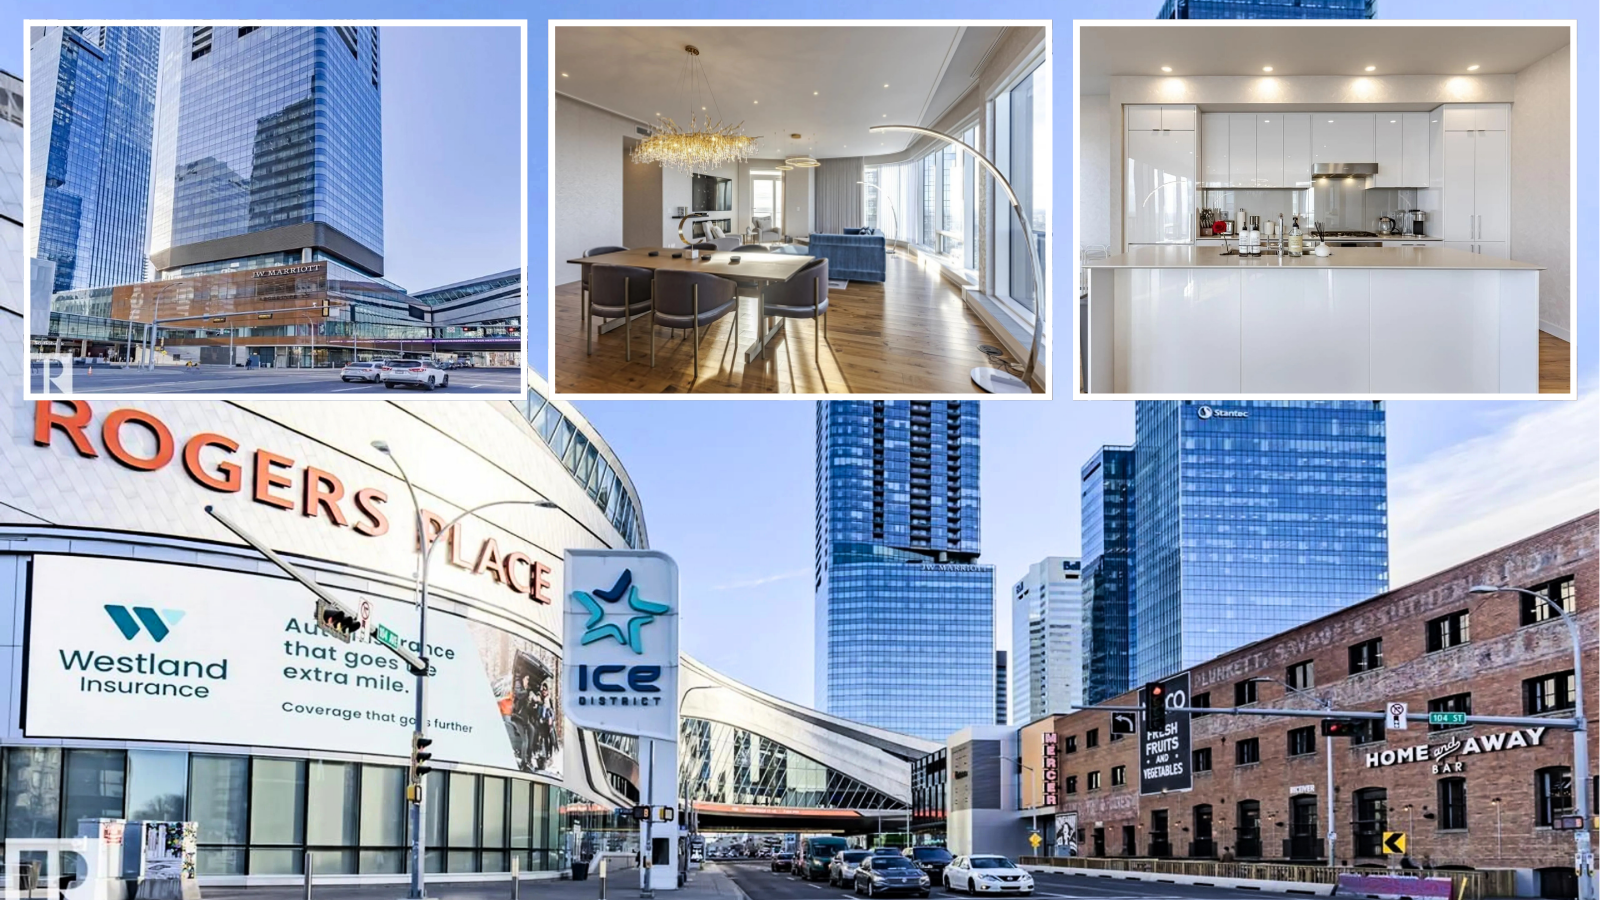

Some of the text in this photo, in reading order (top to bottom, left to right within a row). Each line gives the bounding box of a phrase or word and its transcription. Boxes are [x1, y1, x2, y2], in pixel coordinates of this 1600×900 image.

[251, 264, 321, 279] JW MARRIOTT
[1214, 408, 1249, 418] Stantec
[34, 400, 552, 605] ROGERS PLACE
[59, 649, 228, 681] Westland
[284, 640, 337, 661] that
[344, 651, 399, 670] goes
[80, 676, 210, 699] Insurance
[283, 666, 410, 694] extra mile.
[578, 696, 662, 706] DISTRICT
[281, 701, 362, 721] Coverage
[366, 710, 396, 723] that
[434, 718, 473, 734] further
[1433, 713, 1464, 723] 104 ST
[1145, 736, 1180, 756] FRUITS
[1365, 726, 1546, 768] HOME and AWAY
[1044, 732, 1058, 806] MERCER
[1155, 753, 1170, 764] AND
[1431, 761, 1465, 775] BAR
[1143, 762, 1184, 780] VEGETABLES
